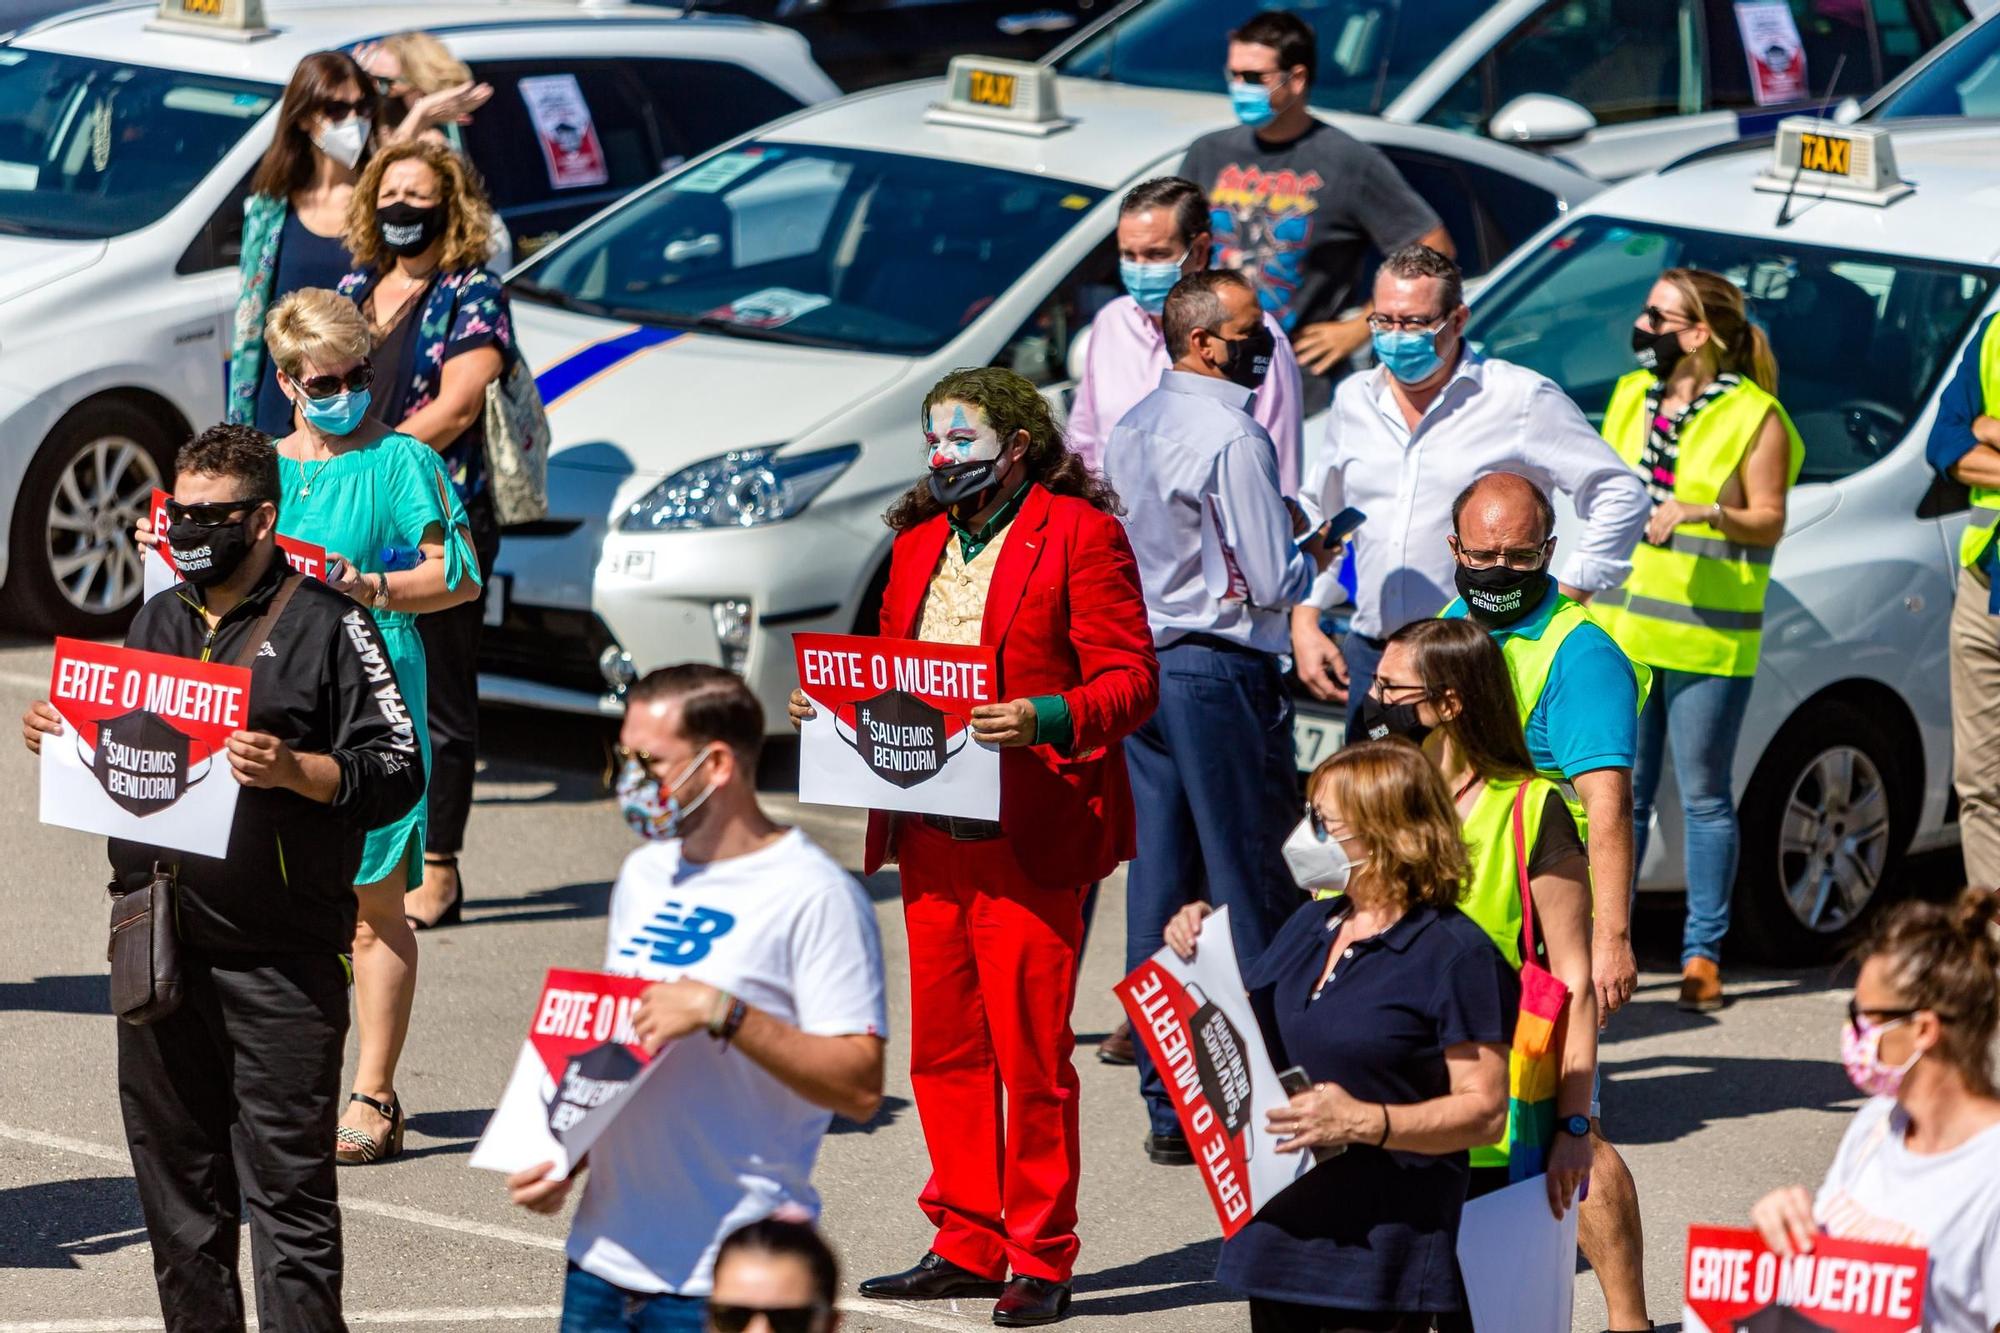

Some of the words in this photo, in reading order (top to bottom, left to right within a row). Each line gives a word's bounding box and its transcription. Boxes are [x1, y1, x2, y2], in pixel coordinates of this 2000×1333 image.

[969, 69, 1017, 108] TAXI
[1801, 131, 1852, 176] TAXI
[1469, 588, 1522, 604] #SALVEMOS
[1472, 597, 1521, 612] BENIDORM
[342, 610, 392, 683] KAPPA
[56, 658, 119, 706] ERTE
[122, 669, 142, 709] O
[143, 673, 243, 727] MUERTE
[804, 649, 865, 688] ERTE
[871, 654, 888, 690] O
[893, 656, 989, 700] MUERTE
[374, 683, 415, 753] KAPPA
[862, 709, 934, 747] #SALVEMOS
[101, 728, 176, 774] #SALVEMOS
[873, 745, 937, 772] BENIDORM
[108, 768, 176, 800] BENIDORM
[534, 988, 599, 1040] ERTE
[593, 995, 616, 1042] O
[1130, 971, 1204, 1105] MUERTE
[1200, 1022, 1241, 1129] #SALVEMOS
[1211, 1010, 1251, 1102] BENIDORM
[1192, 1104, 1214, 1134] O
[1203, 1132, 1248, 1223] ERTE
[1689, 1246, 1754, 1303] ERTE
[1754, 1251, 1778, 1305] O
[1776, 1253, 1918, 1320] MUERTE
